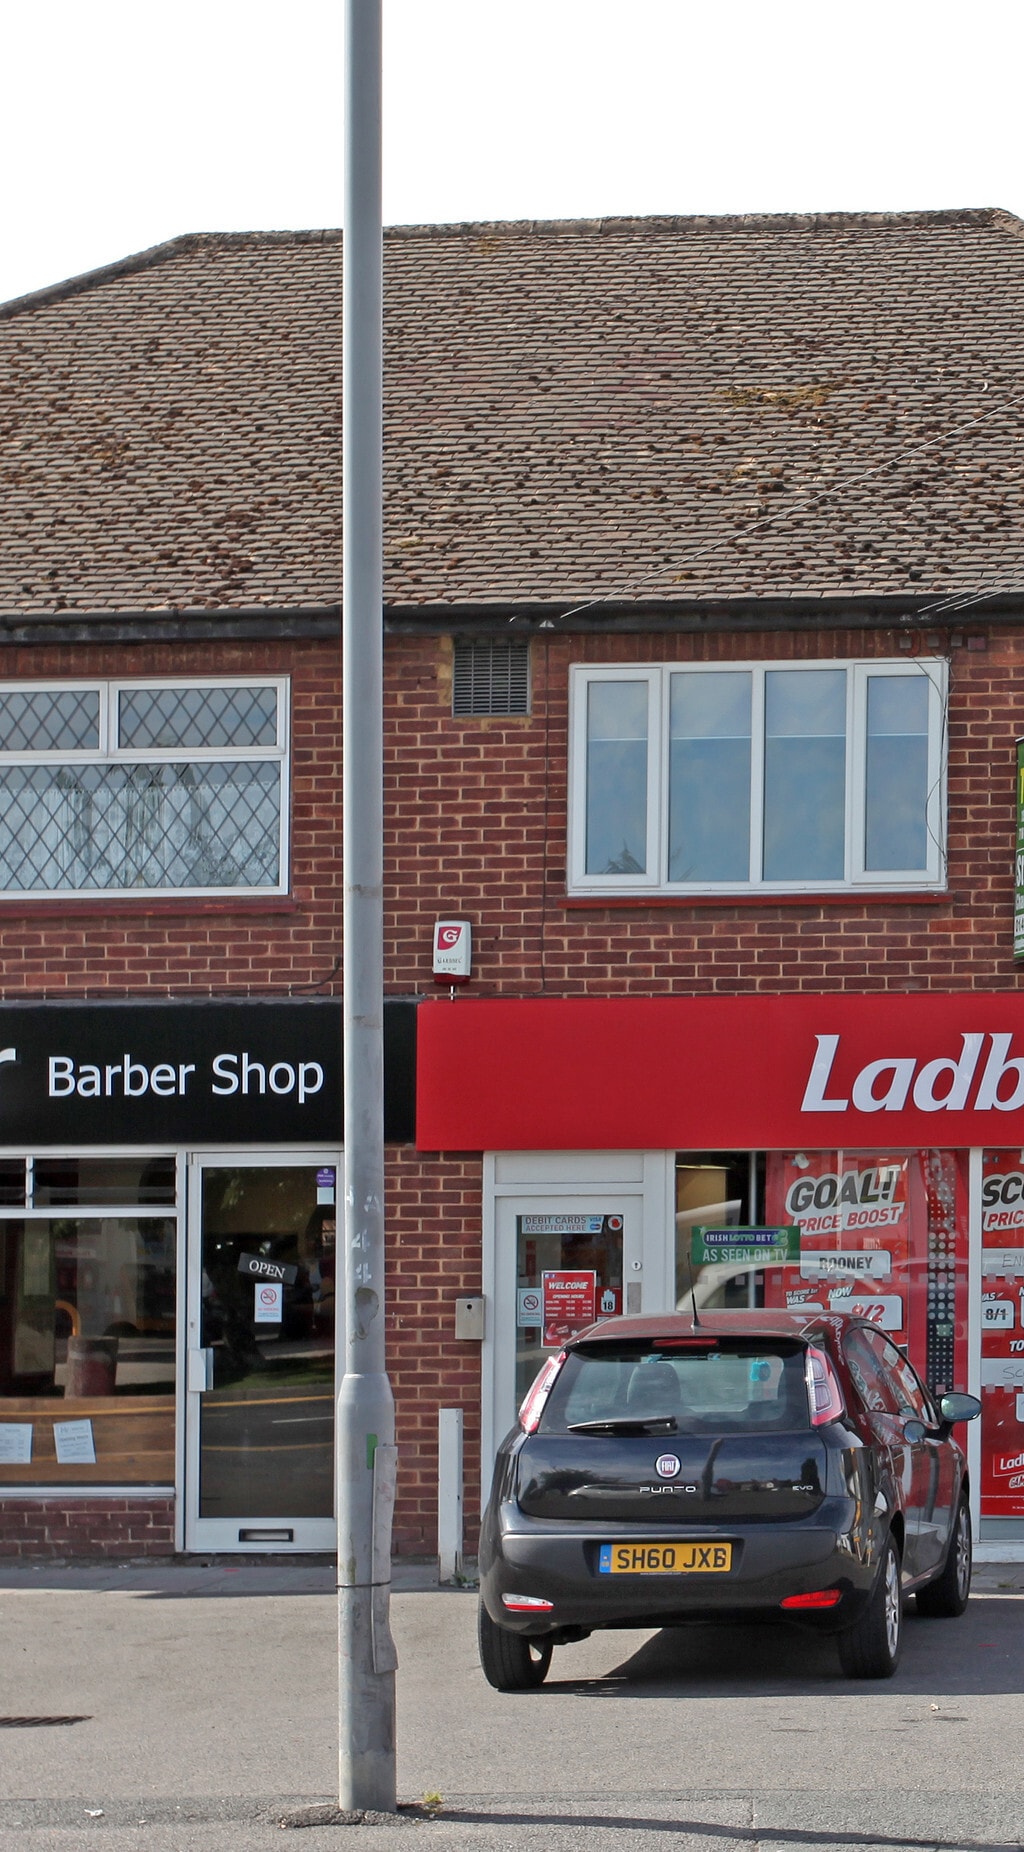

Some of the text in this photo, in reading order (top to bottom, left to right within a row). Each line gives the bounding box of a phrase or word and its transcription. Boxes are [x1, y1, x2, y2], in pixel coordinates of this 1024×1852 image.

[48, 1052, 324, 1103] Barber Shop
[789, 1168, 898, 1213] GOAL!
[525, 1216, 587, 1225] DEBIT CARDS
[798, 1206, 900, 1232] PRICE BOOST
[526, 1224, 564, 1232] ACCEPTED
[706, 1233, 772, 1242] IRISH LOTTO BET
[702, 1248, 788, 1262] AS SEEN ON TV
[249, 1260, 286, 1279] OPEN
[819, 1256, 873, 1270] ROONEY
[548, 1281, 589, 1290] WELCOME
[828, 1286, 853, 1299] NOW
[603, 1301, 614, 1311] 18
[786, 1295, 805, 1305] WAS
[985, 1308, 1007, 1321] 8/1
[1009, 1339, 1024, 1352] TO
[661, 1460, 675, 1471] FIAT
[639, 1485, 697, 1493] PUNTO
[617, 1547, 727, 1569] SH60 JXB
